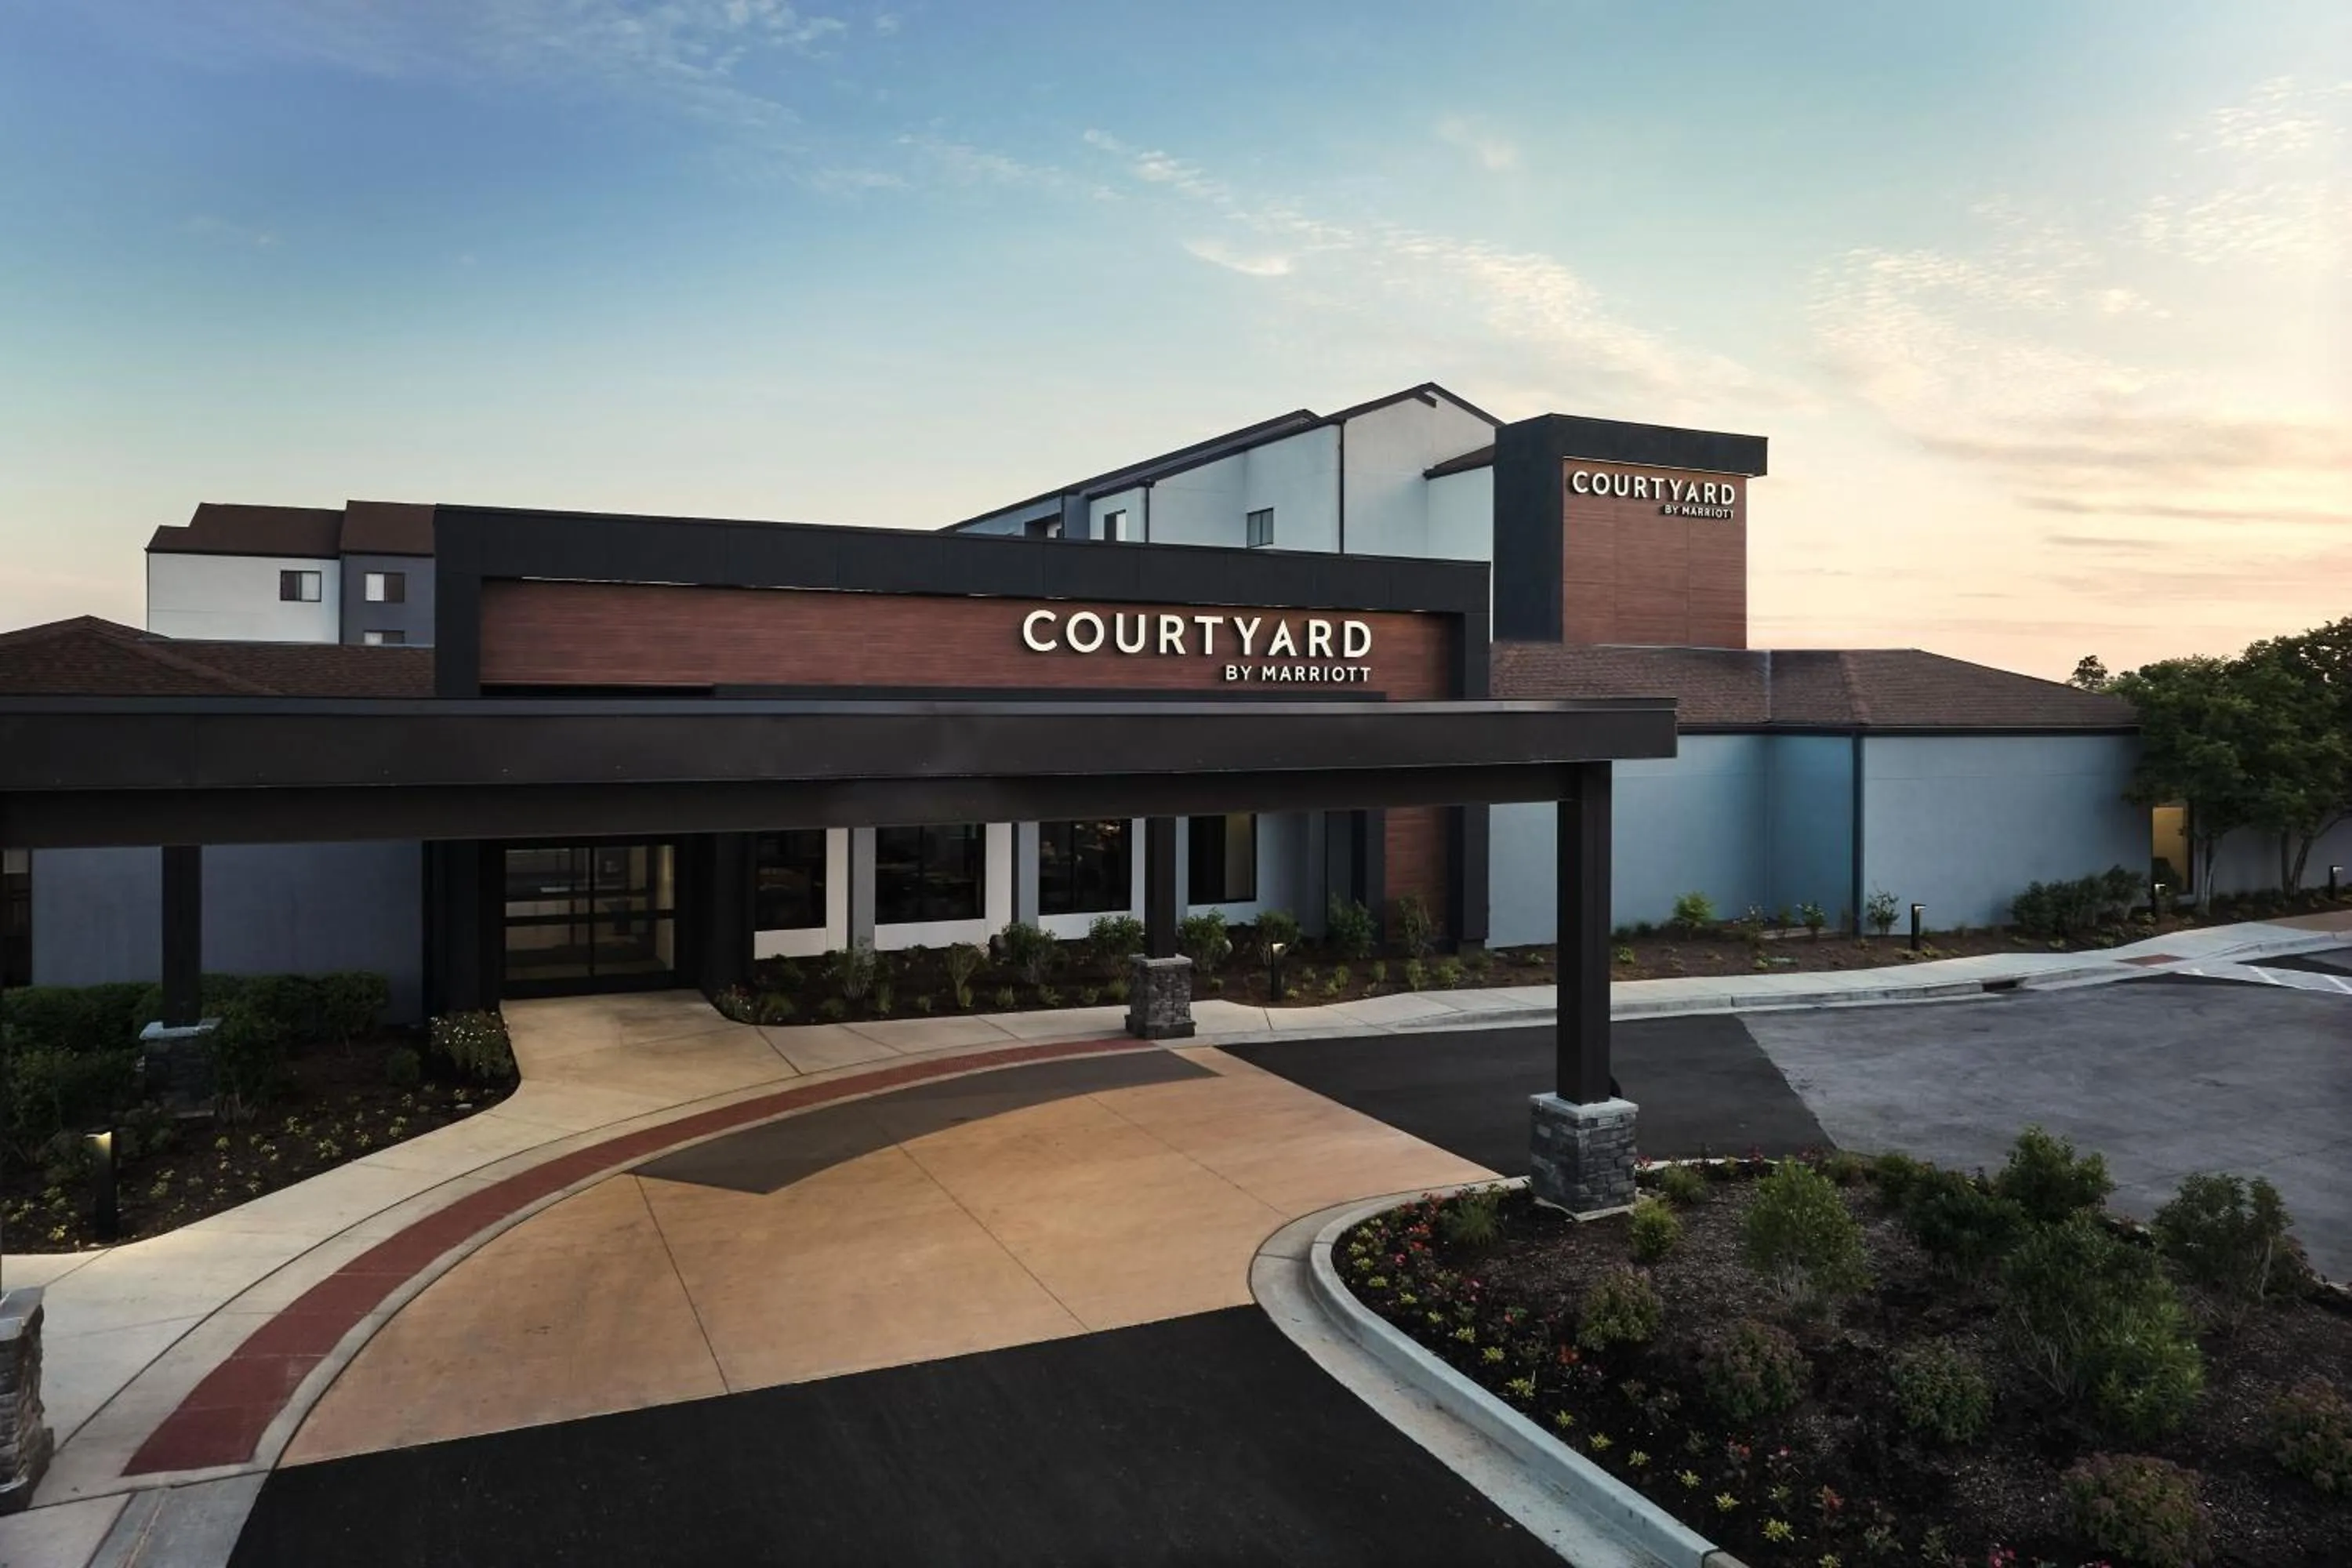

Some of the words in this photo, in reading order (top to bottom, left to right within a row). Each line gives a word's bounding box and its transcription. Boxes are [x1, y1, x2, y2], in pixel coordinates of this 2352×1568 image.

[1572, 470, 1736, 505] COURTYARD
[1664, 504, 1678, 514] BY
[1682, 506, 1734, 519] MARRIOTT
[1022, 609, 1372, 658] COURTYARD
[1225, 664, 1252, 681] BY
[1261, 666, 1372, 682] MARRIOTT
